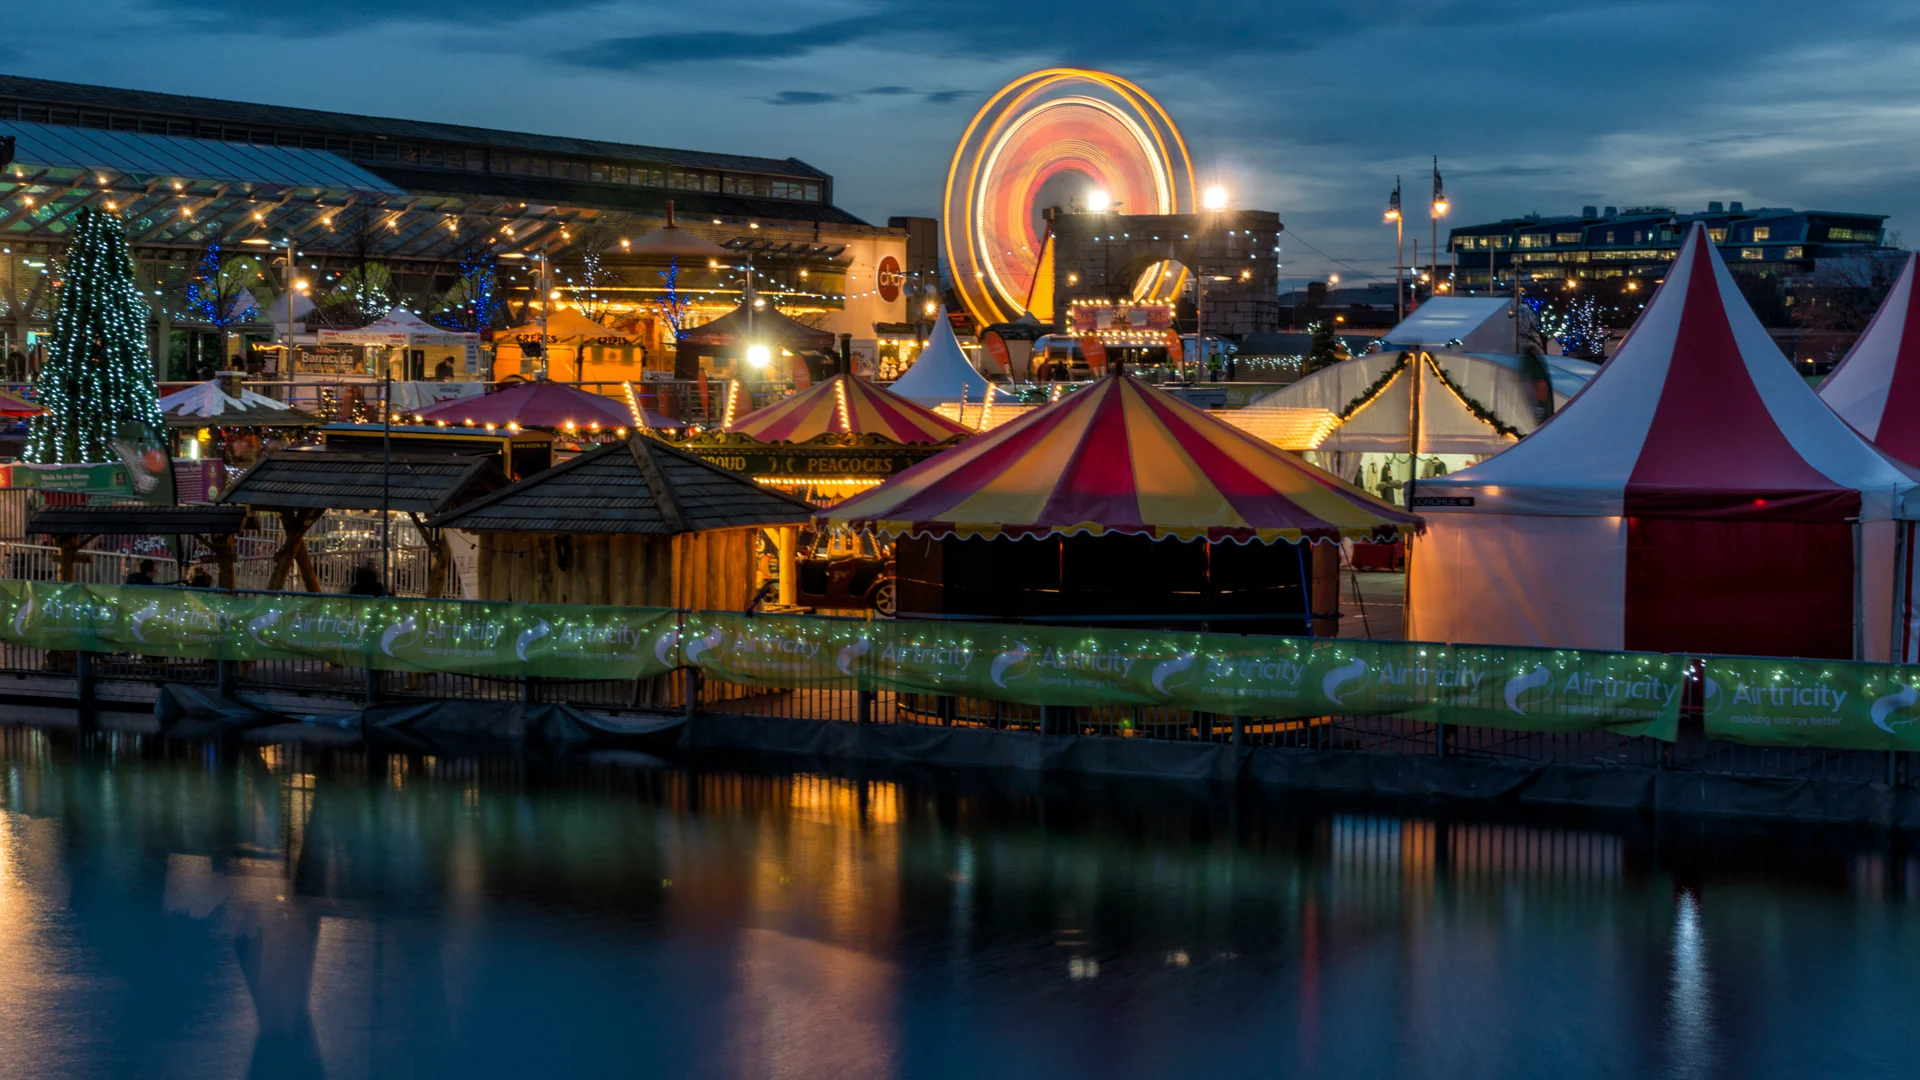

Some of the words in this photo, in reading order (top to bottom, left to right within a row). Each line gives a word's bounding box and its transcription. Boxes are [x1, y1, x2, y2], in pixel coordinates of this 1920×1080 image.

[1076, 312, 1093, 323] BAR
[516, 334, 558, 344] CREPES
[598, 336, 628, 345] CREPES
[302, 351, 354, 364] Barracuda
[700, 456, 747, 471] ROUD
[807, 457, 893, 472] PEACOCKS
[1412, 498, 1457, 506] DONOHUE
[288, 611, 368, 640] Airtricity
[424, 618, 502, 647] Airtricity
[558, 622, 641, 650] Airtricity
[732, 631, 820, 659] Airtricity
[880, 641, 974, 671] Airtricity
[1040, 646, 1136, 678] Airtricity
[1204, 657, 1306, 686] Airtricity
[1378, 660, 1486, 692] Airtricity
[1038, 676, 1071, 688] making
[1074, 678, 1104, 688] energy
[1562, 671, 1678, 708] Airtricity
[1201, 686, 1234, 696] making
[1270, 688, 1298, 698] better
[1376, 693, 1412, 704] making
[1733, 680, 1848, 712] Airtricity
[1560, 704, 1599, 716] making
[1730, 714, 1770, 726] making
[1773, 716, 1808, 727] energy
[1810, 716, 1842, 726] better
